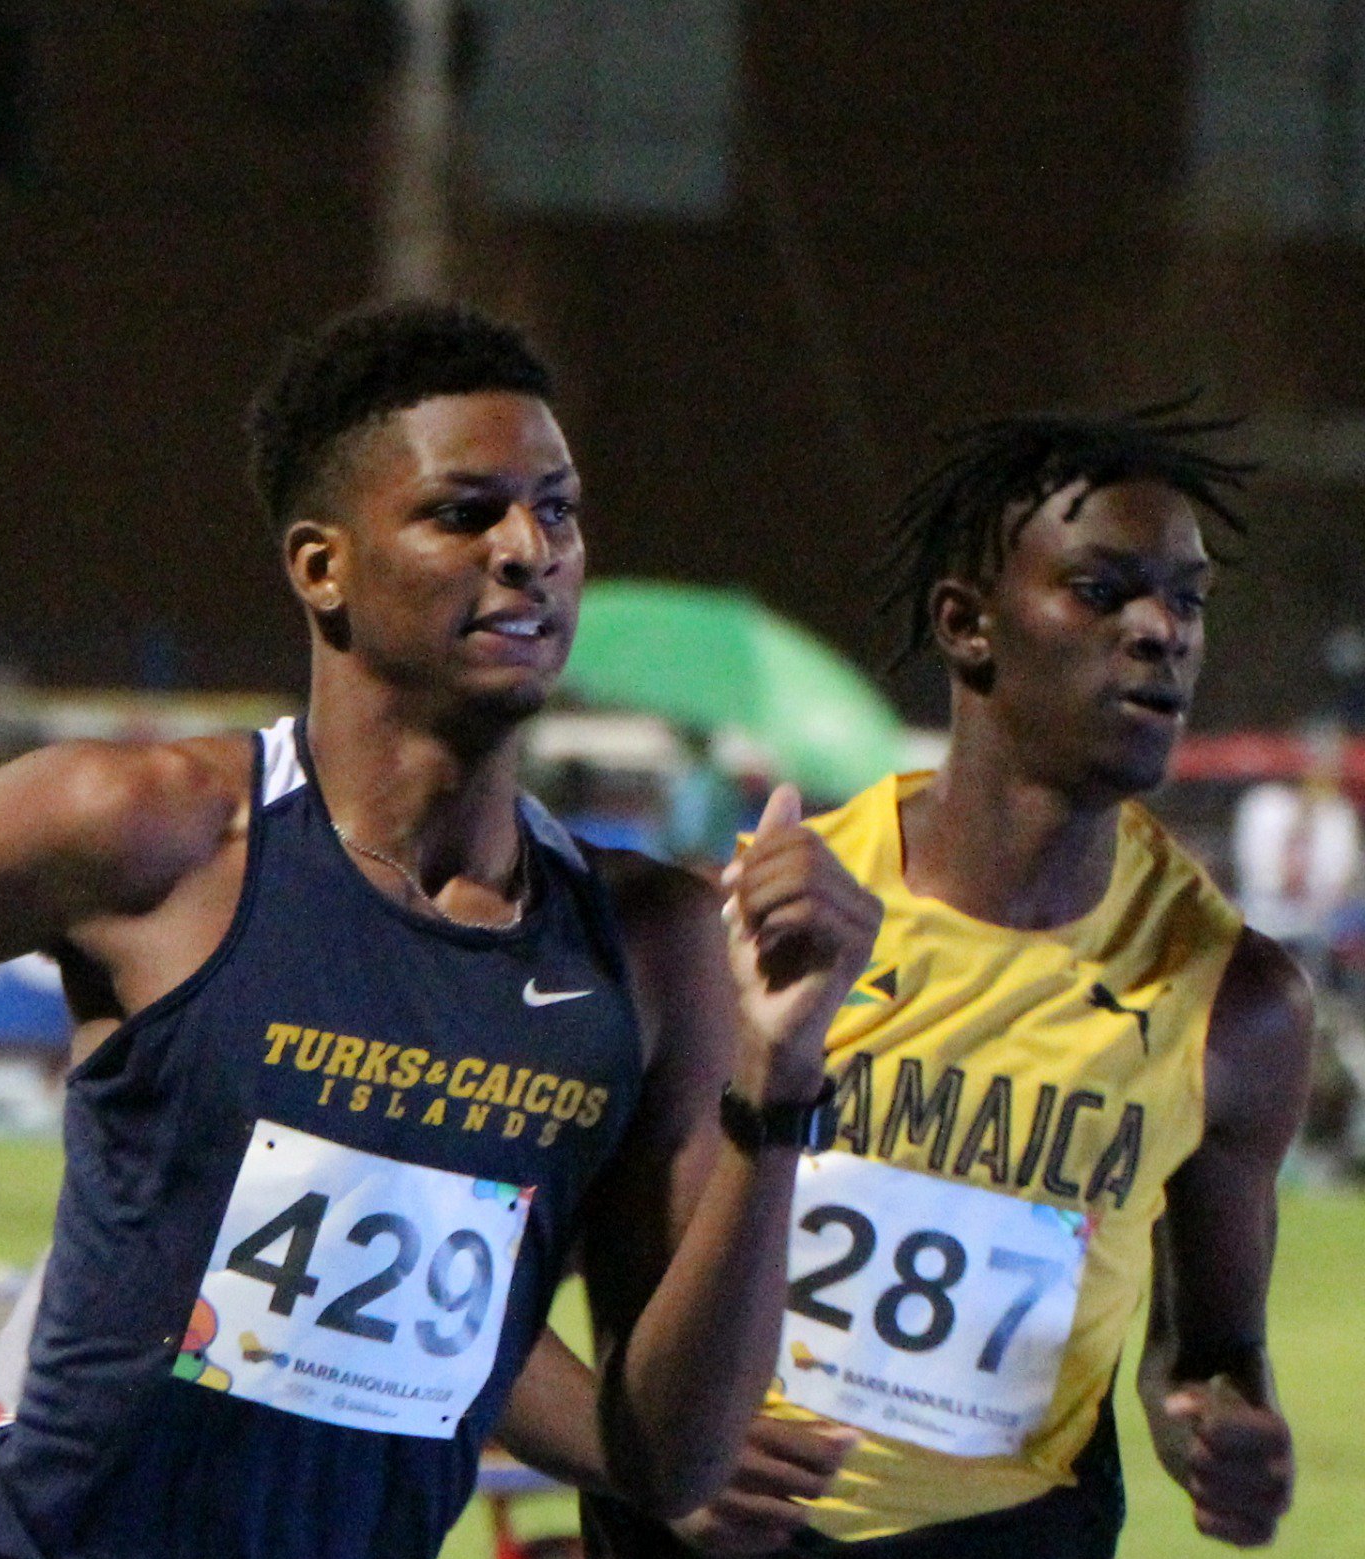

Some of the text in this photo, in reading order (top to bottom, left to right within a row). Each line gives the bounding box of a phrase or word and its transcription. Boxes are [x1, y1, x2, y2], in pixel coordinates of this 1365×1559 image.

[317, 1078, 563, 1148] ISLANDS
[835, 1051, 1146, 1210] AMAICA
[225, 1190, 494, 1358] 429
[785, 1204, 1065, 1376] 287
